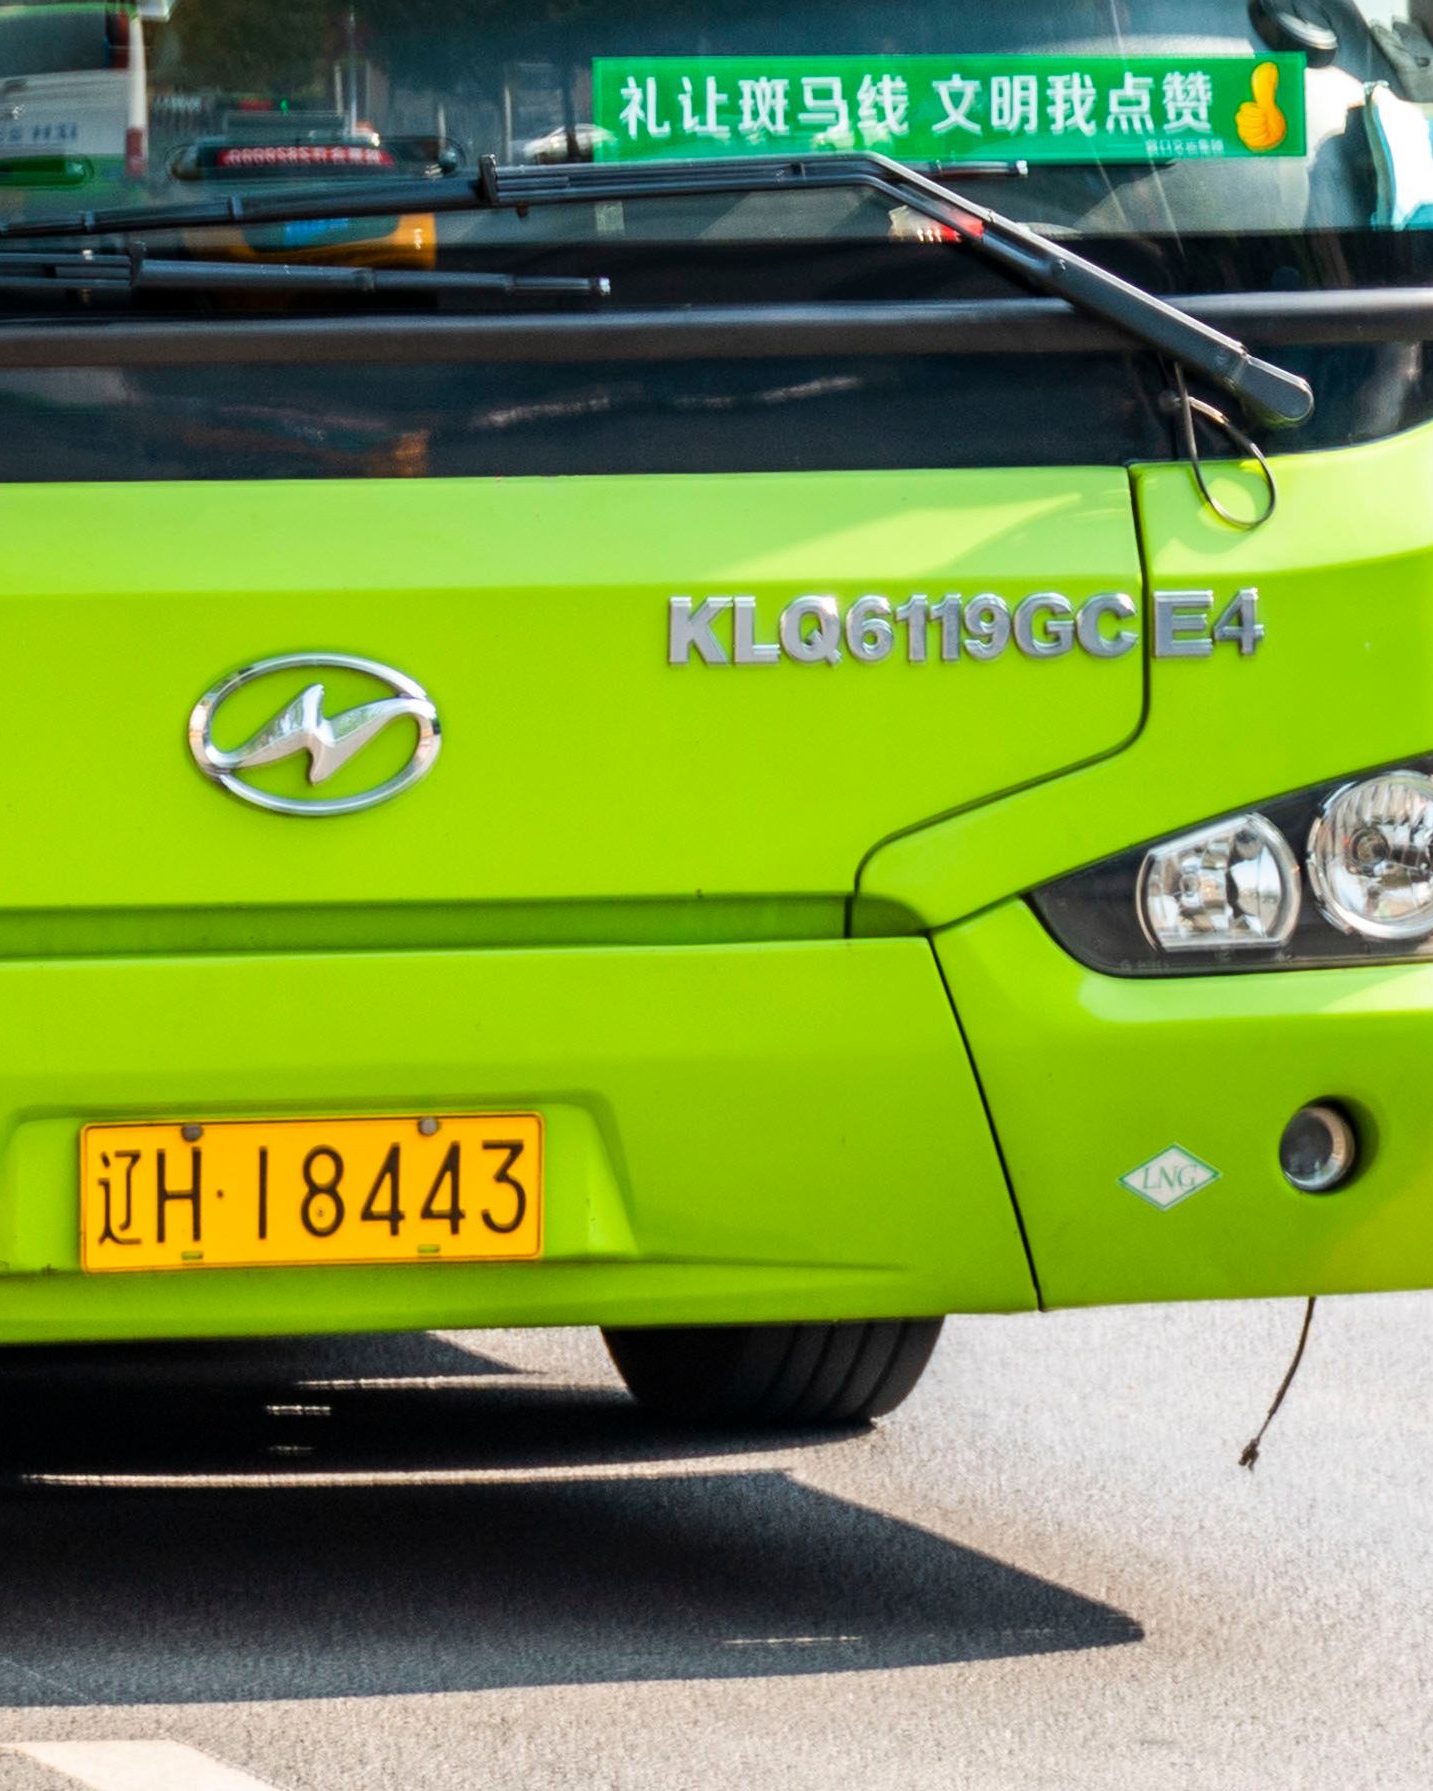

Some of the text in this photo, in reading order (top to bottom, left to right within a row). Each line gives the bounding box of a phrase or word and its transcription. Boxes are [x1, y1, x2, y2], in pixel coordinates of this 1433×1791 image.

[619, 70, 1215, 141] 礼让斑马线 文明我点赞
[1142, 1164, 1198, 1189] LNG
